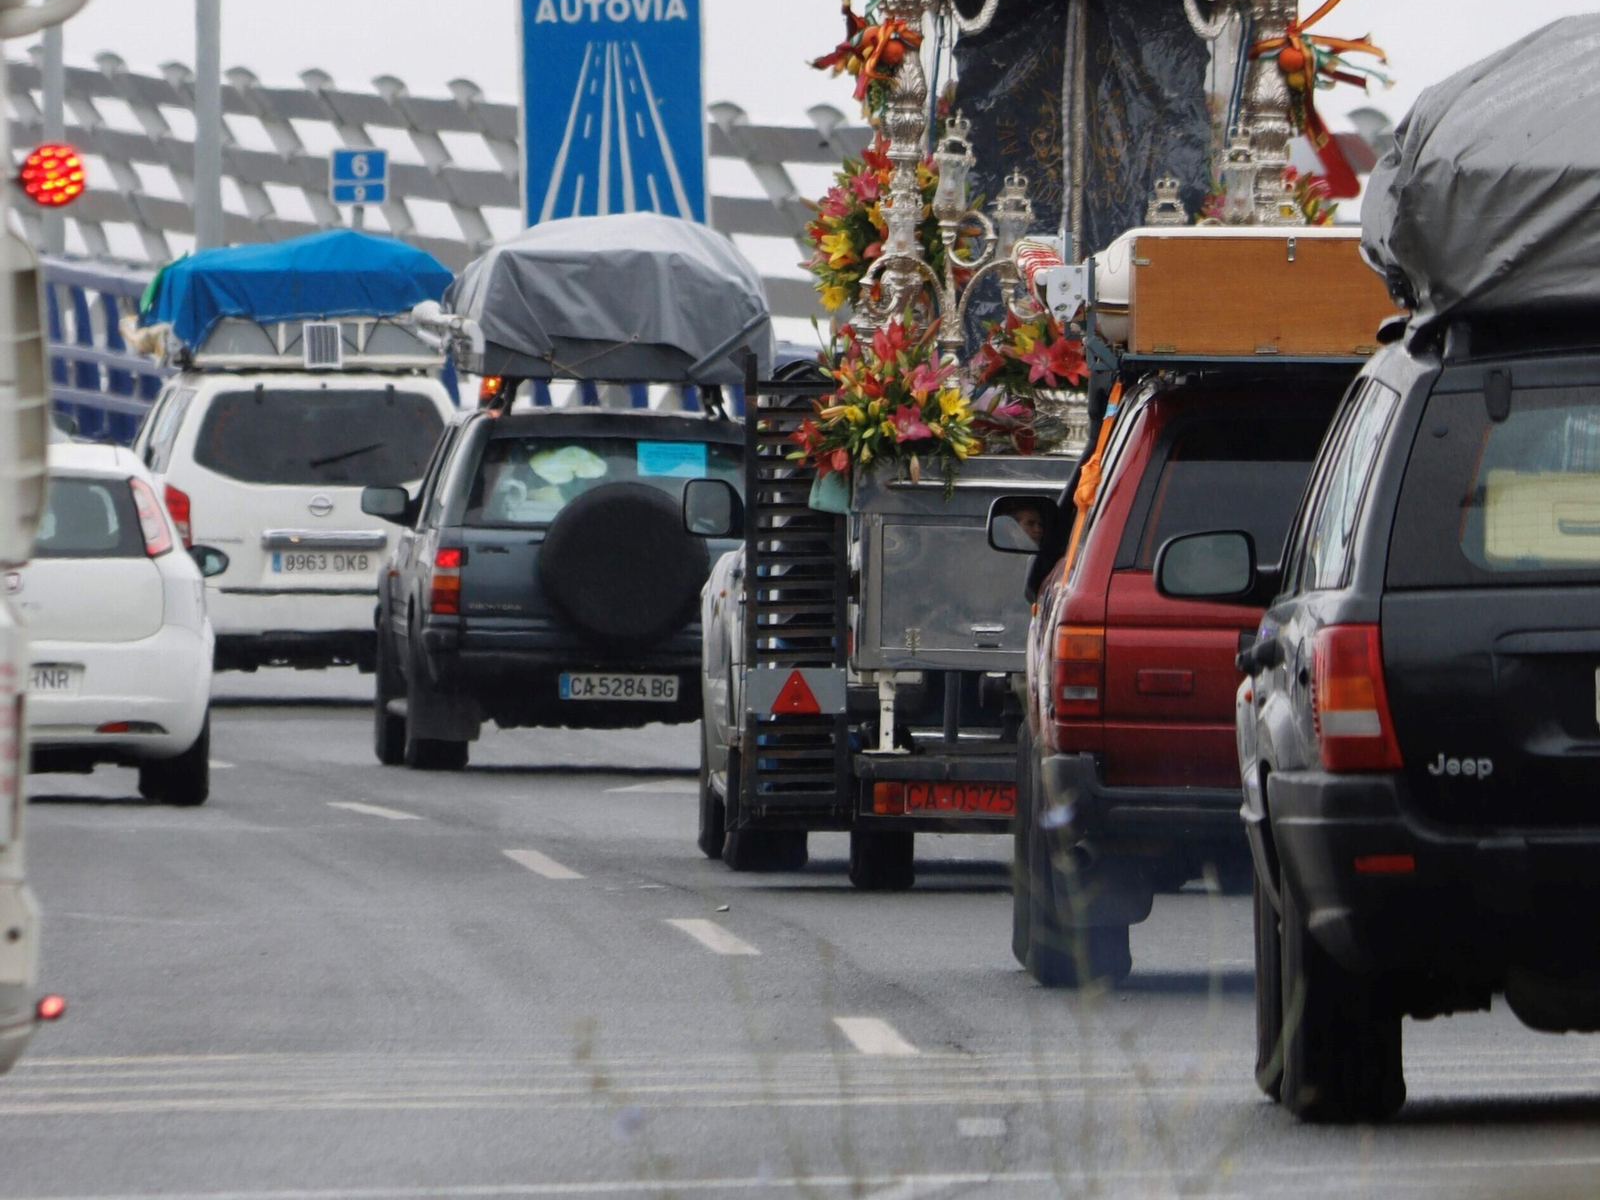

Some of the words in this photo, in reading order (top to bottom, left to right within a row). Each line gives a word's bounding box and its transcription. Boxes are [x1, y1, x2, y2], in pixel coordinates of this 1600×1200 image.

[350, 153, 370, 178] 6
[284, 553, 328, 572] 8963
[333, 553, 369, 572] DKB
[1427, 752, 1494, 780] Jeep
